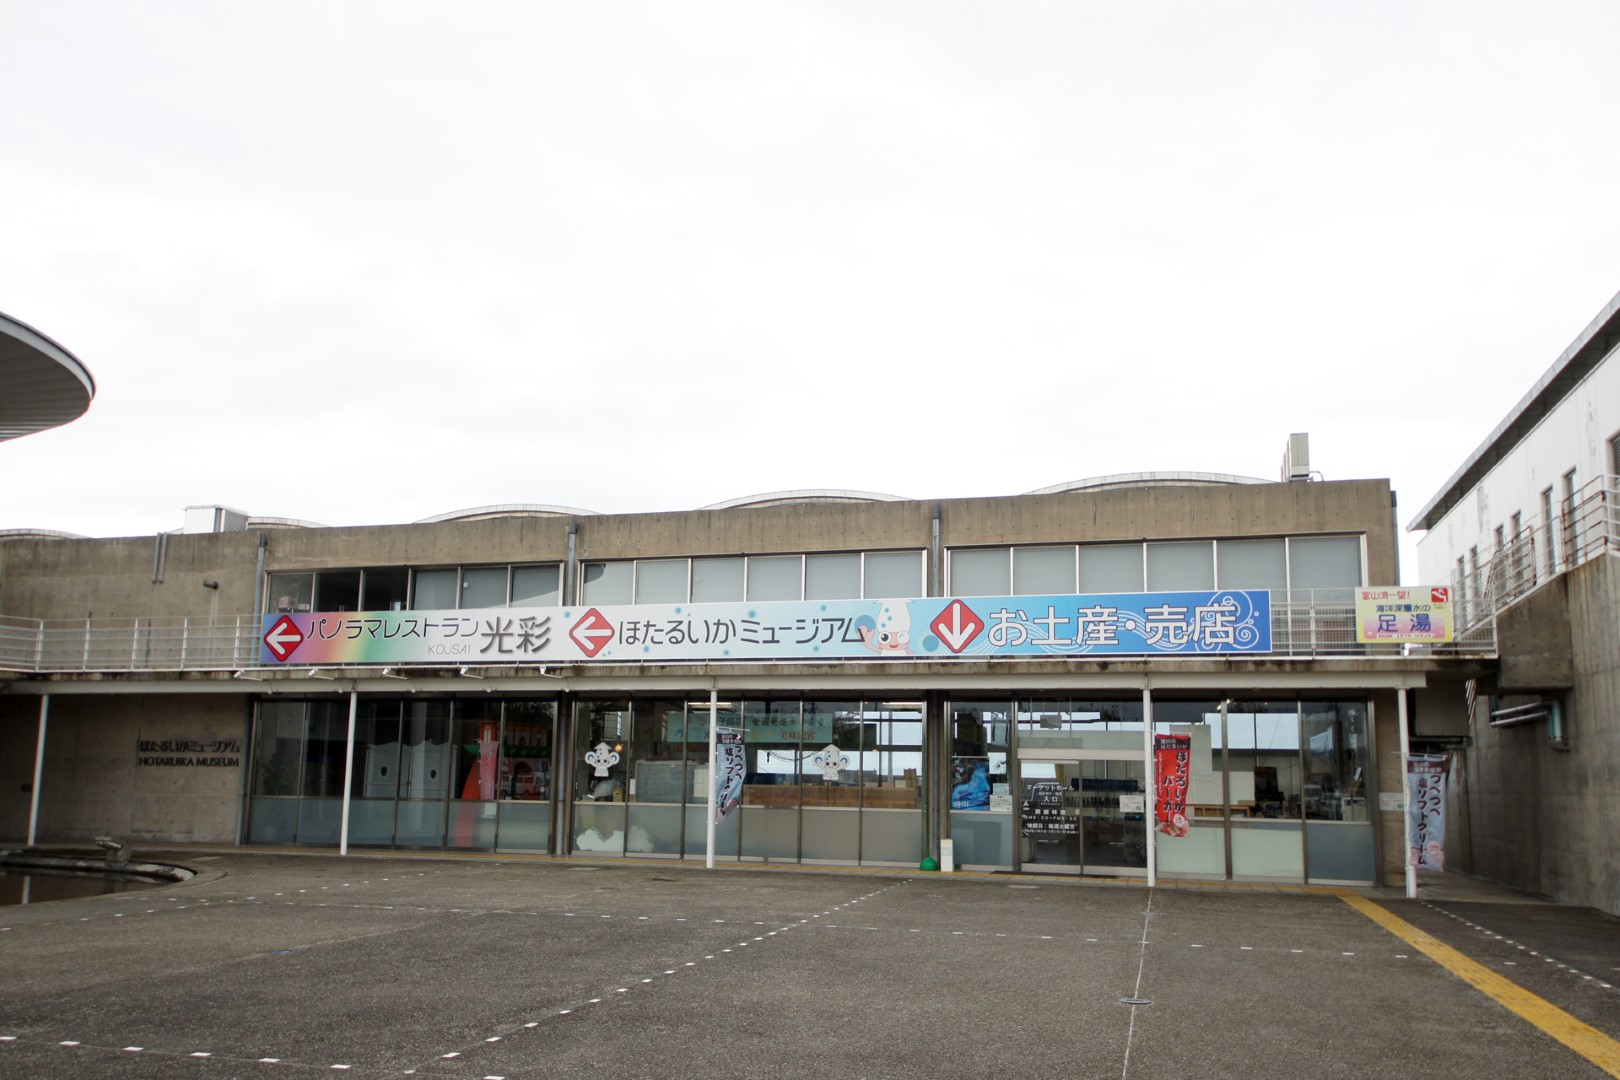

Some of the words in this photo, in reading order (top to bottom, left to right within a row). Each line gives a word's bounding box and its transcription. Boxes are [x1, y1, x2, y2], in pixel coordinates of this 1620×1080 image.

[1375, 604, 1431, 613] 海洋深層水の
[306, 617, 479, 640] パノラマレストラン
[479, 615, 552, 655] 光彩
[618, 617, 866, 645] ほたるいかミュージアム
[987, 603, 1237, 648] お土産・売店
[1377, 613, 1431, 633] 足湯
[427, 643, 471, 656] KOUSAI
[139, 739, 240, 753] ほたるいかミュージアム
[138, 756, 194, 767] HOTARUIKA
[195, 756, 240, 767] MUSEUM
[1176, 751, 1188, 813] ほたるいか
[1163, 774, 1175, 825] バーガー
[1417, 777, 1428, 866] 塩ソフトクリーム
